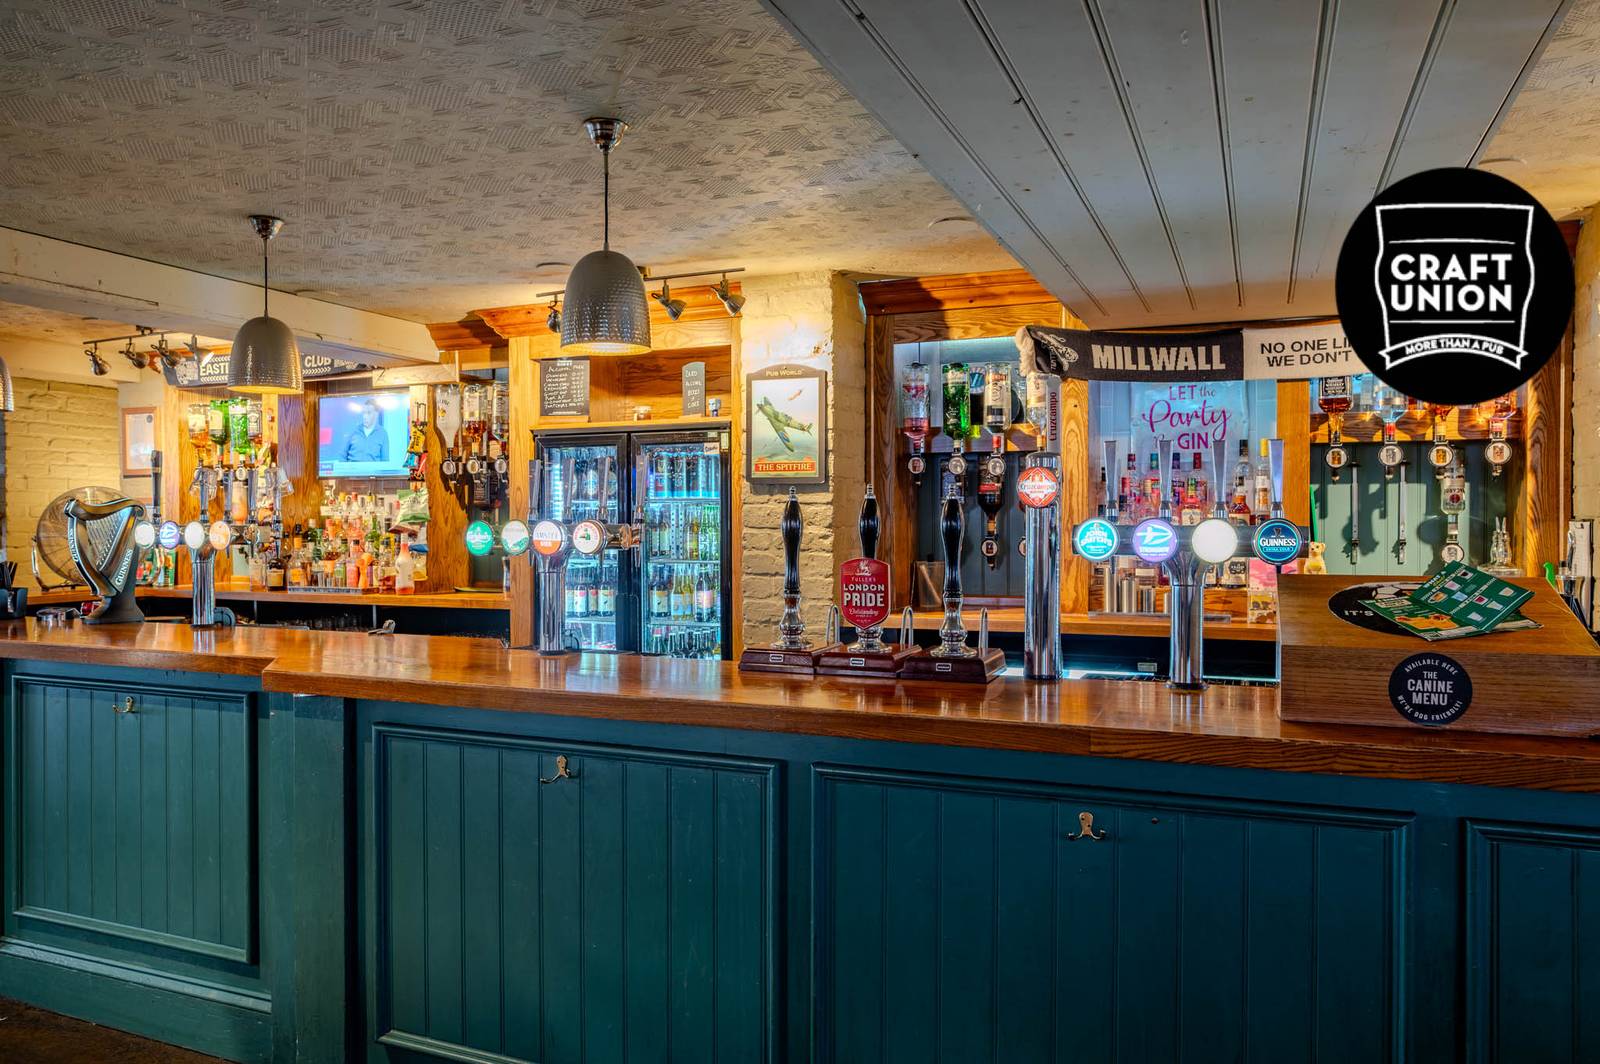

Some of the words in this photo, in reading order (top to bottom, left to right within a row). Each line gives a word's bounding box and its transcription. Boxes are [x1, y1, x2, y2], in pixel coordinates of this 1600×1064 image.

[1261, 343, 1285, 354] NO
[1291, 339, 1328, 352] ONE
[1333, 337, 1351, 349] LI
[1091, 344, 1226, 371] MILLWALL
[1267, 355, 1294, 367] WE
[1300, 350, 1352, 365] DON'T
[1169, 385, 1197, 400] LET
[1200, 384, 1216, 398] the
[1142, 400, 1232, 441] Party
[758, 463, 775, 471] THE
[776, 462, 812, 471] SPITFIRE
[1260, 538, 1296, 546] GUINNESS
[115, 549, 133, 585] GUINNESS
[843, 583, 885, 591] LONDON
[843, 592, 885, 607] PRIDE
[1404, 659, 1440, 672] AVAILABLE
[1441, 662, 1459, 675] HERE
[1423, 671, 1438, 679] THE
[1407, 679, 1454, 693] CANINE
[1412, 692, 1448, 705] MENU
[1397, 695, 1414, 714] WE'RE
[1414, 711, 1428, 720] DOG
